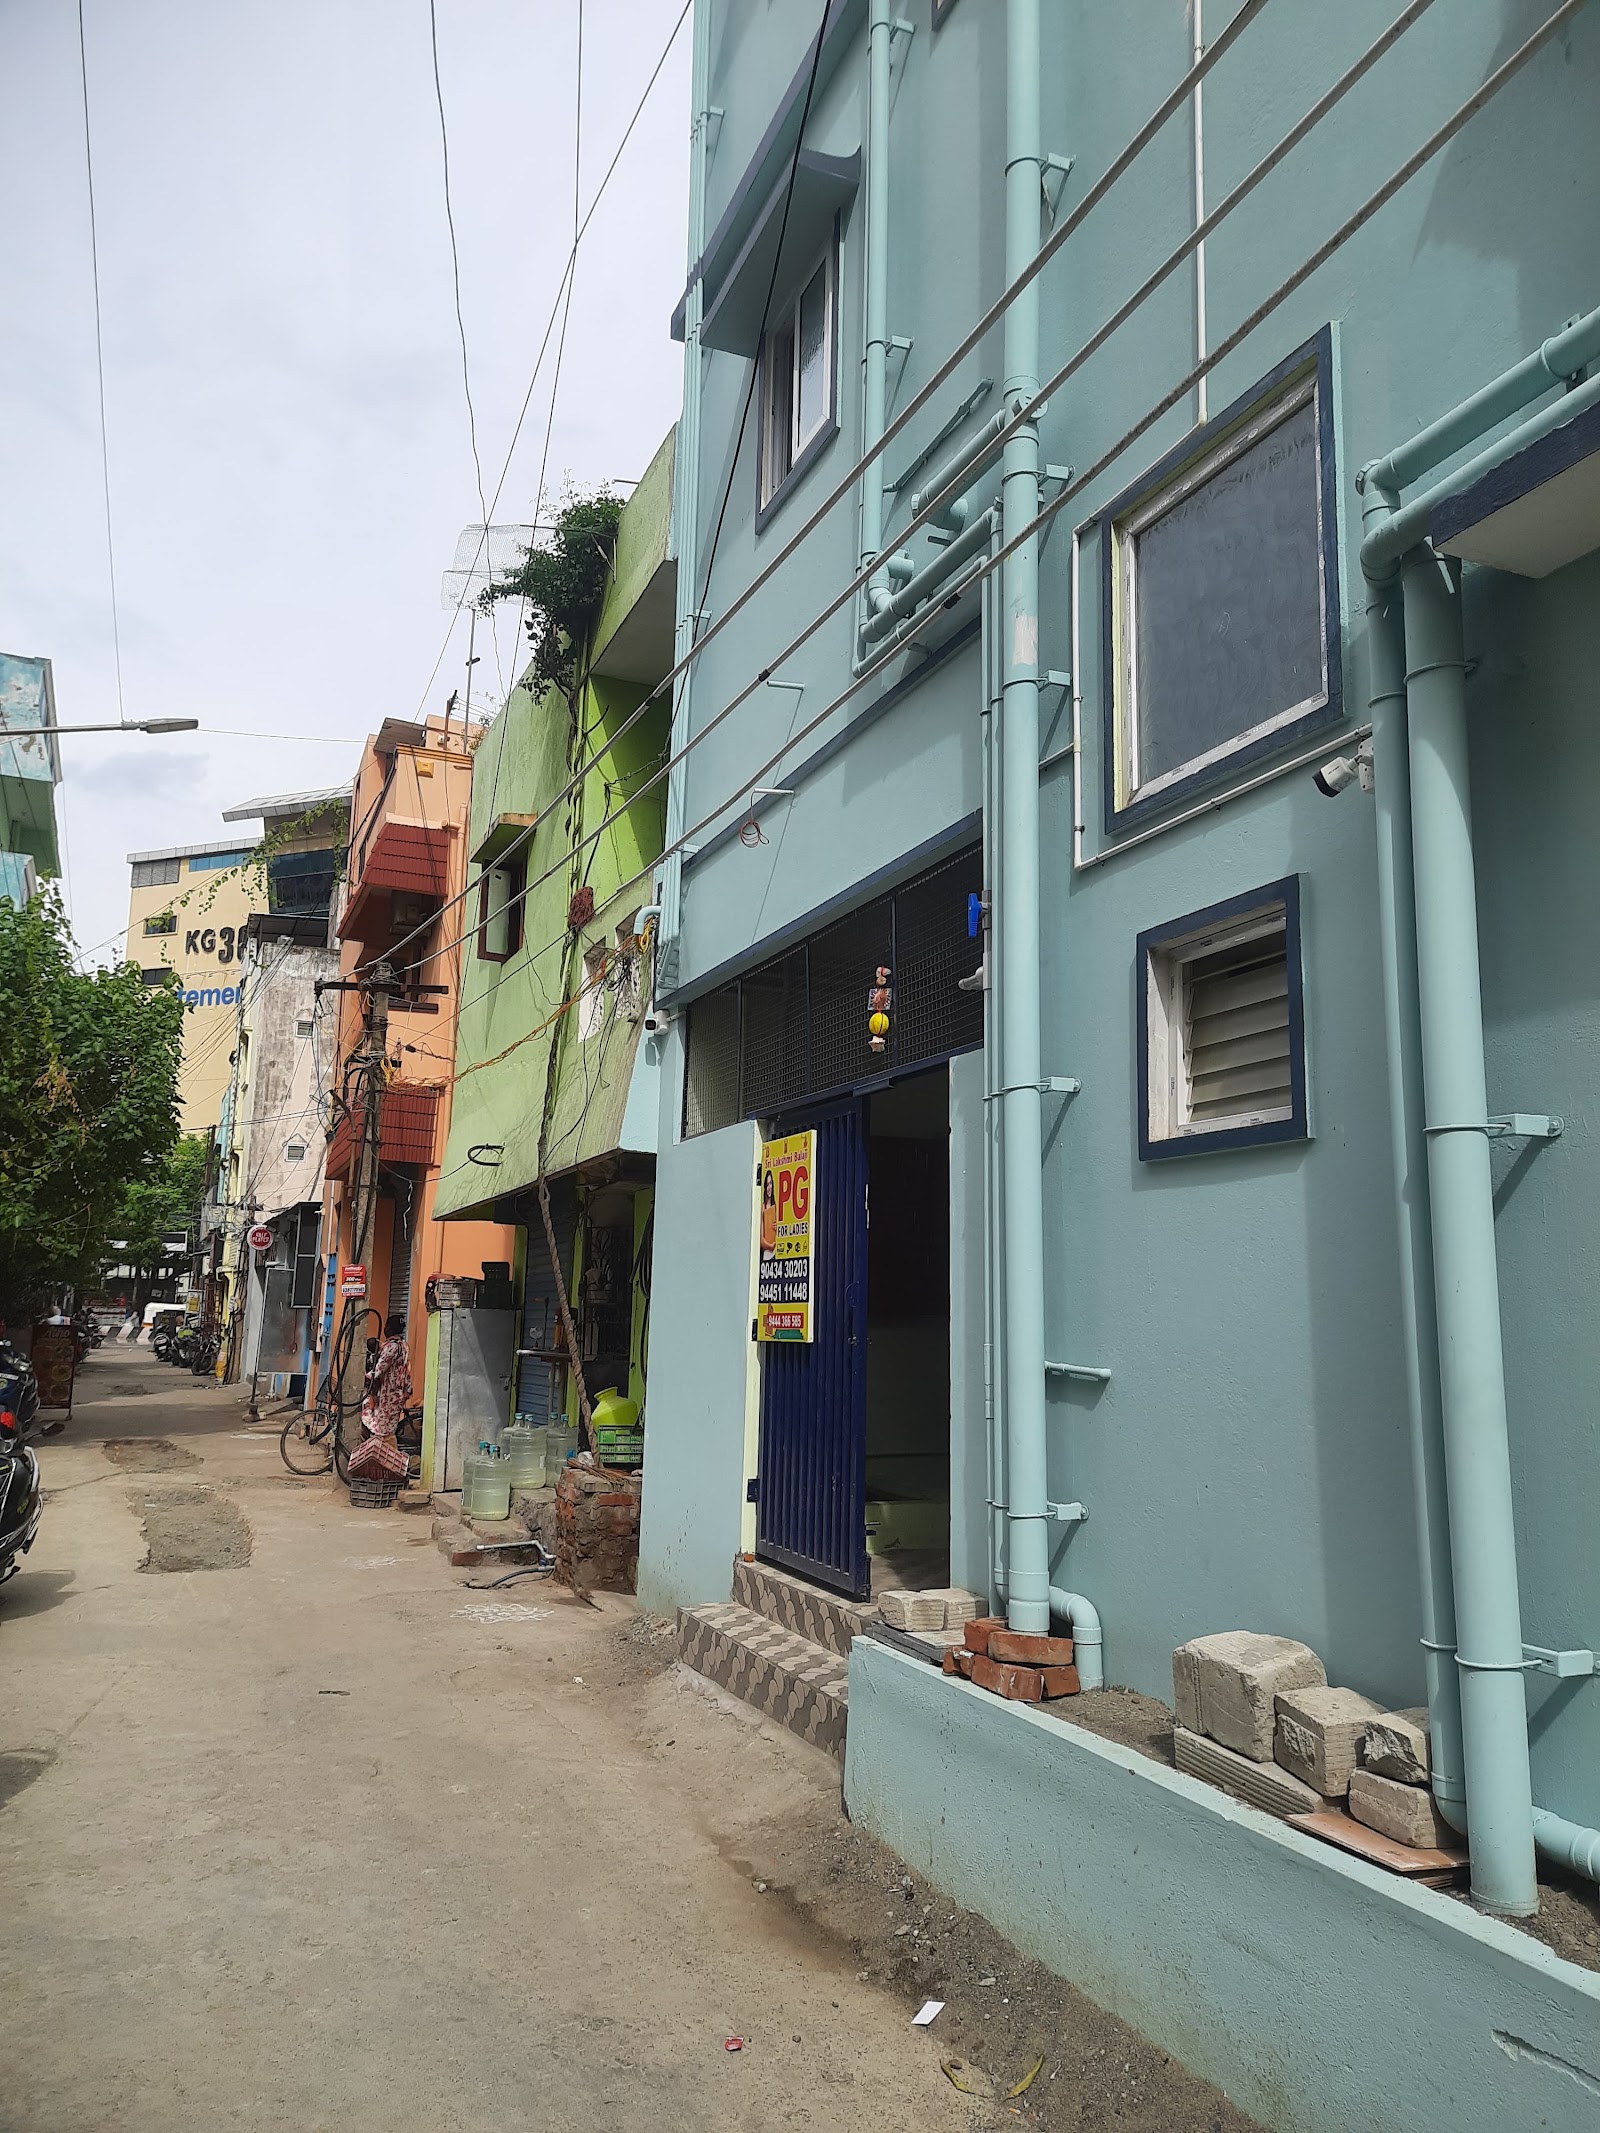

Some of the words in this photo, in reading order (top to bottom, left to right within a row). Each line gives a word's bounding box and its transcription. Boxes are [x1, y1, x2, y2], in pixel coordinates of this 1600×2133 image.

[773, 1152, 793, 1167] Lakshmi
[794, 1148, 808, 1162] Balaji
[778, 1165, 809, 1222] PG
[778, 1224, 788, 1238] FOR
[789, 1222, 808, 1236] LADIES
[761, 1261, 783, 1279] 90434
[784, 1259, 808, 1278] 30203
[760, 1284, 782, 1301] 94451
[784, 1282, 808, 1301] 11448
[768, 1315, 781, 1327] 9444
